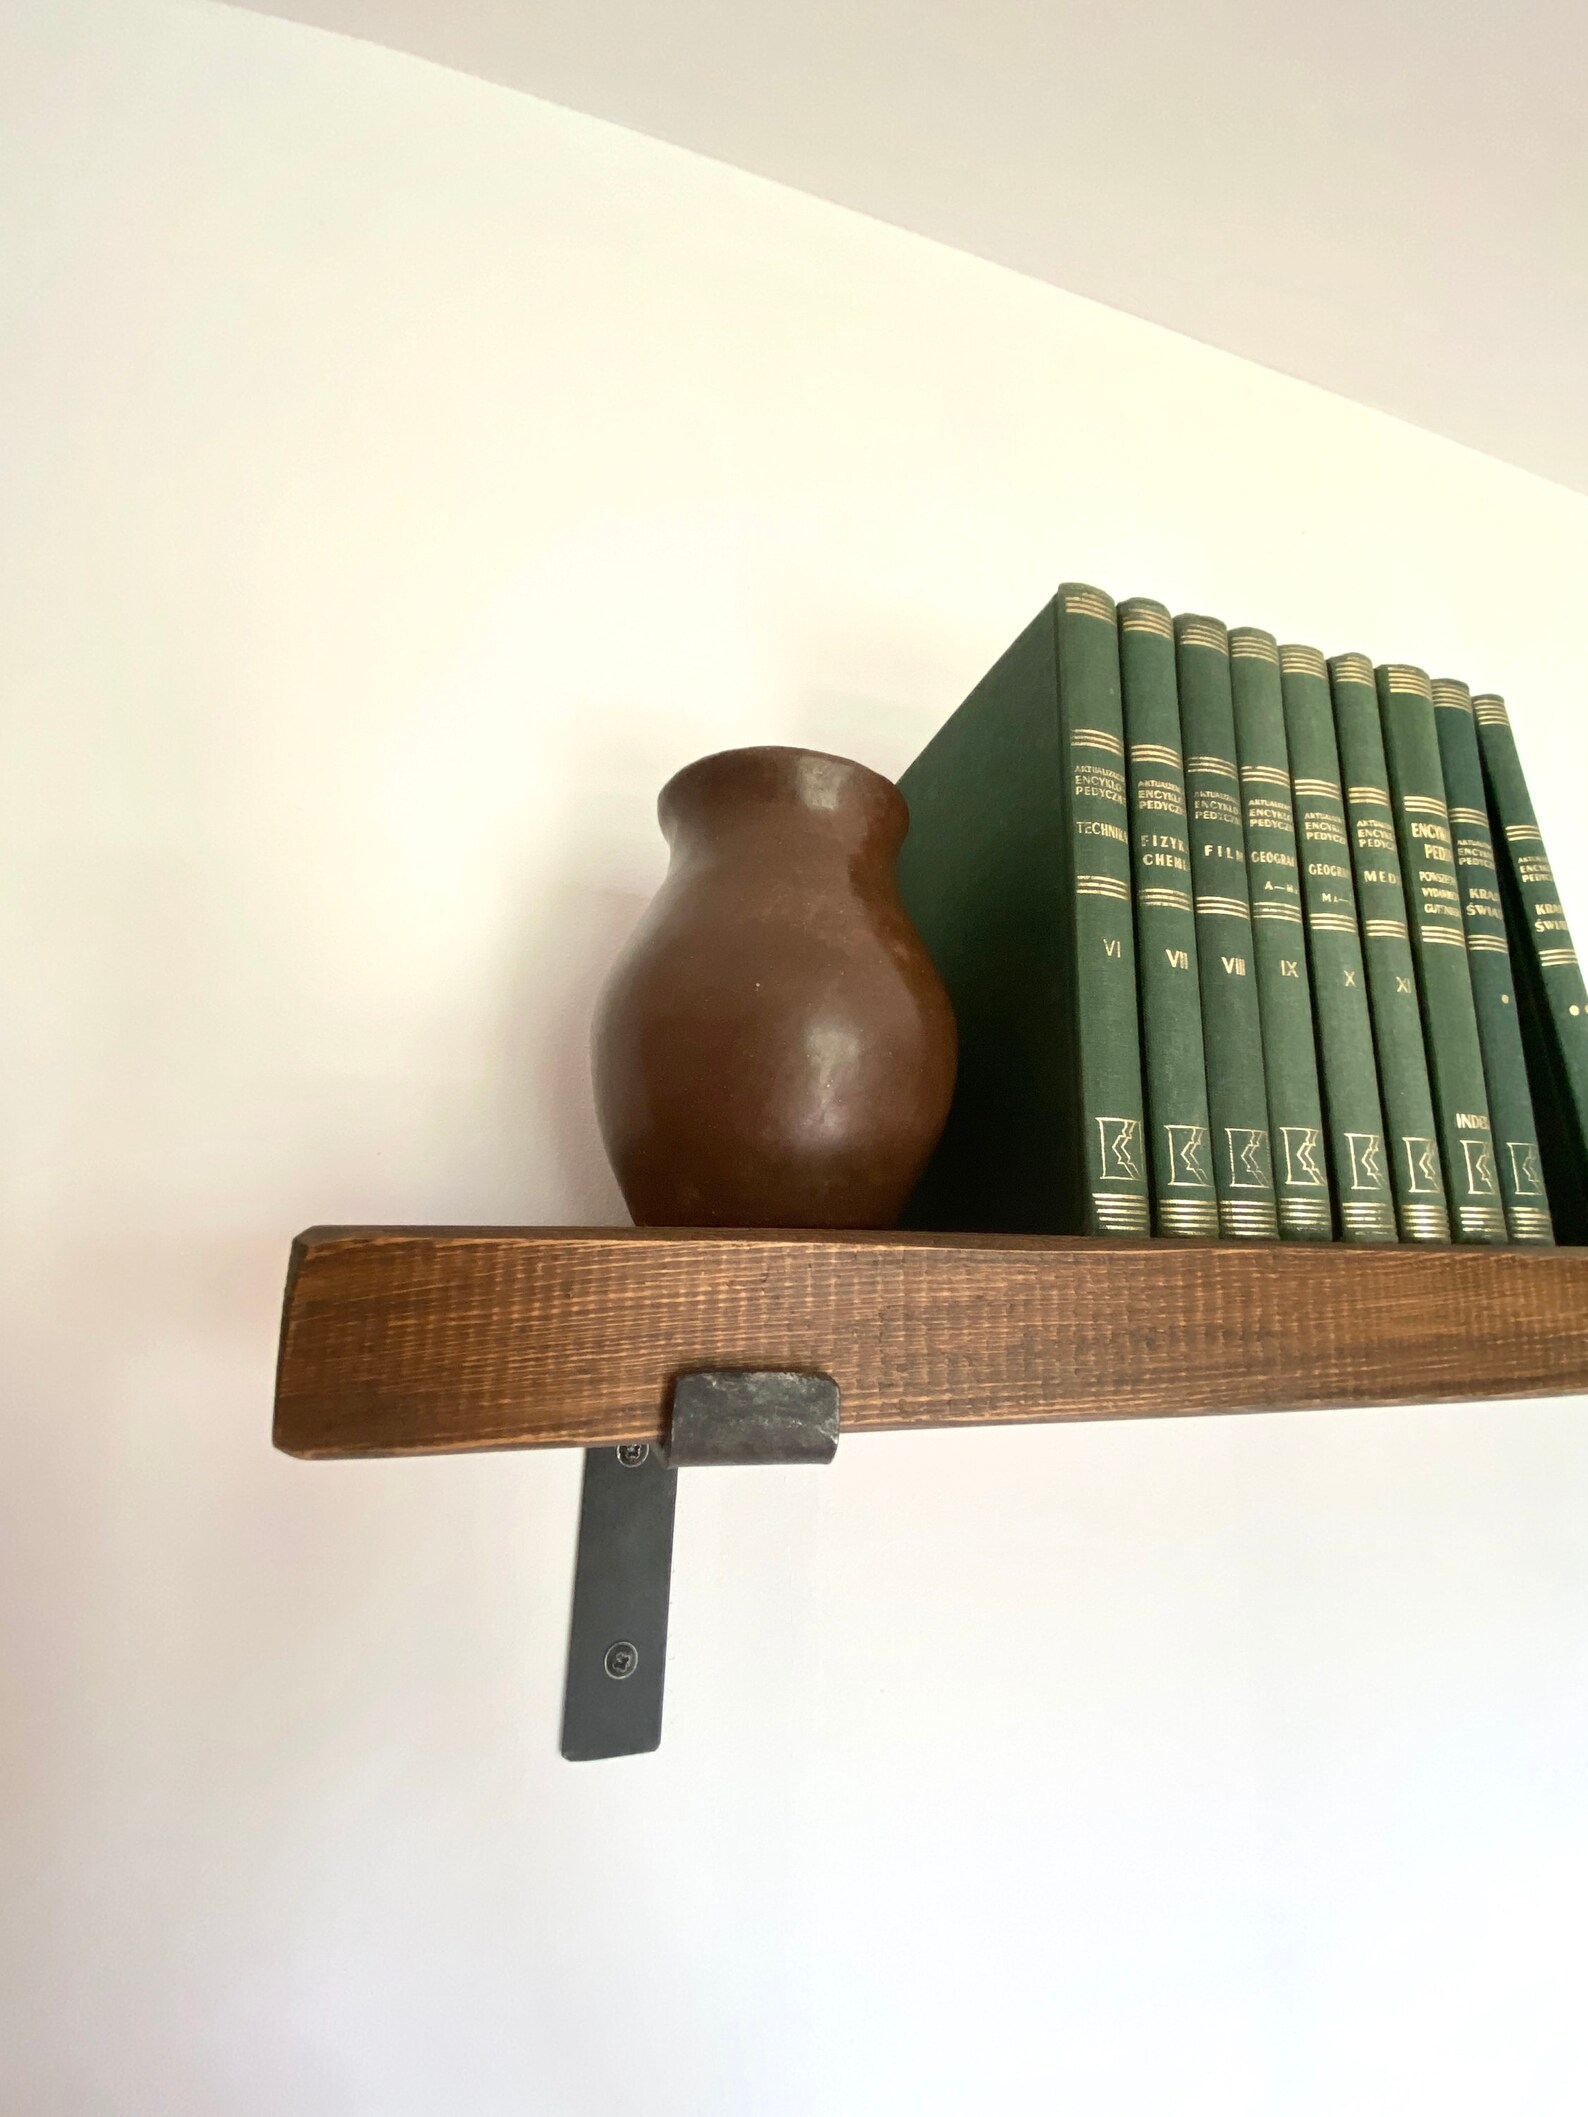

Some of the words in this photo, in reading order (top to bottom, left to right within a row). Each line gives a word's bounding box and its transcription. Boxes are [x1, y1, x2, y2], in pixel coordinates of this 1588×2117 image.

[1103, 939, 1121, 958] VI
[1165, 949, 1188, 970] VII
[1221, 956, 1246, 977] VIII
[1280, 960, 1299, 978] IX
[1344, 970, 1356, 987] X
[1396, 976, 1411, 993] XI
